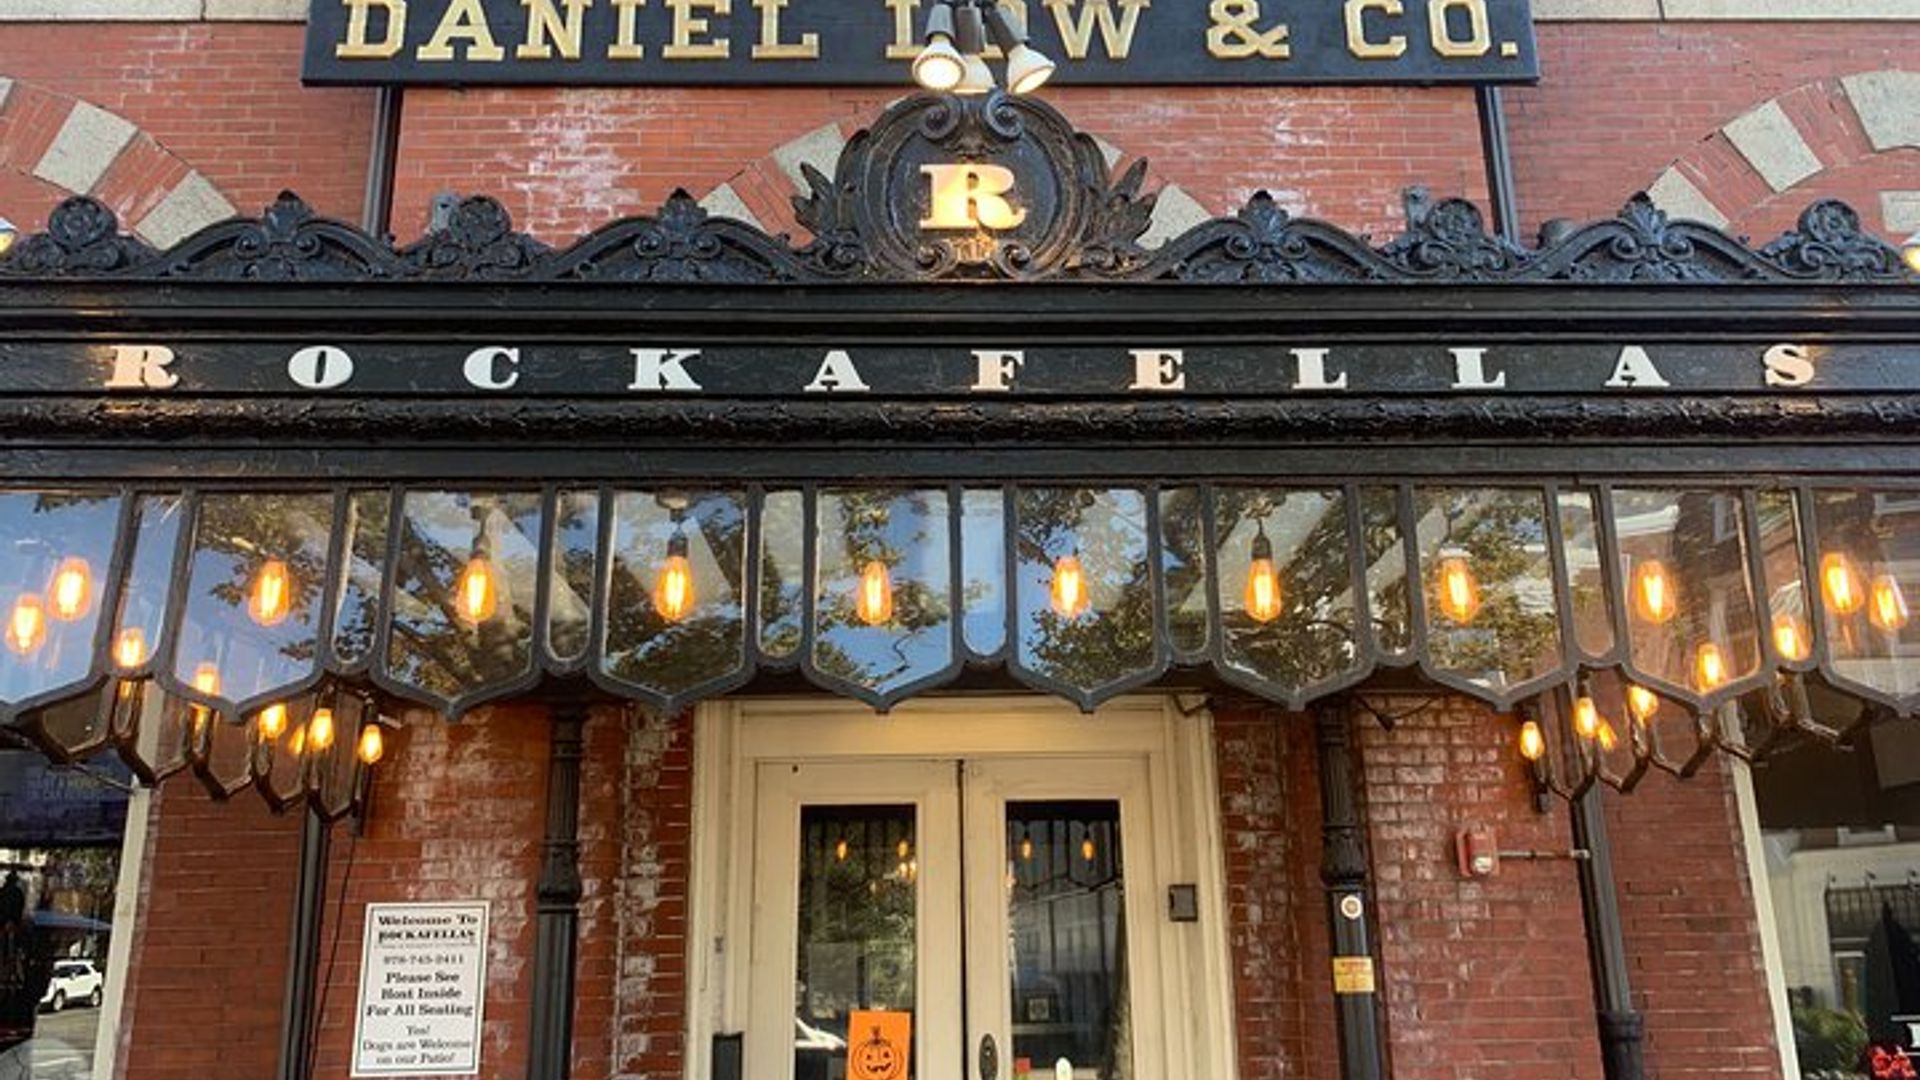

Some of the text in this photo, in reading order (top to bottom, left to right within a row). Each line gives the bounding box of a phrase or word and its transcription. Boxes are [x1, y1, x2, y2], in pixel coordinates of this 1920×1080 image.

[335, 0, 820, 60] DANIEL
[1205, 0, 1291, 59] &
[1344, 0, 1519, 58] CO.
[919, 163, 1027, 230] R
[103, 344, 1817, 392] ROCKAFELLAS
[378, 914, 478, 926] Welcome To
[386, 971, 461, 984] Please See
[381, 987, 463, 1000] Host Inside
[366, 1004, 474, 1018] For All Seating
[362, 1038, 471, 1053] Dogs are Welcome
[376, 1056, 392, 1065] on
[395, 1055, 417, 1065] our
